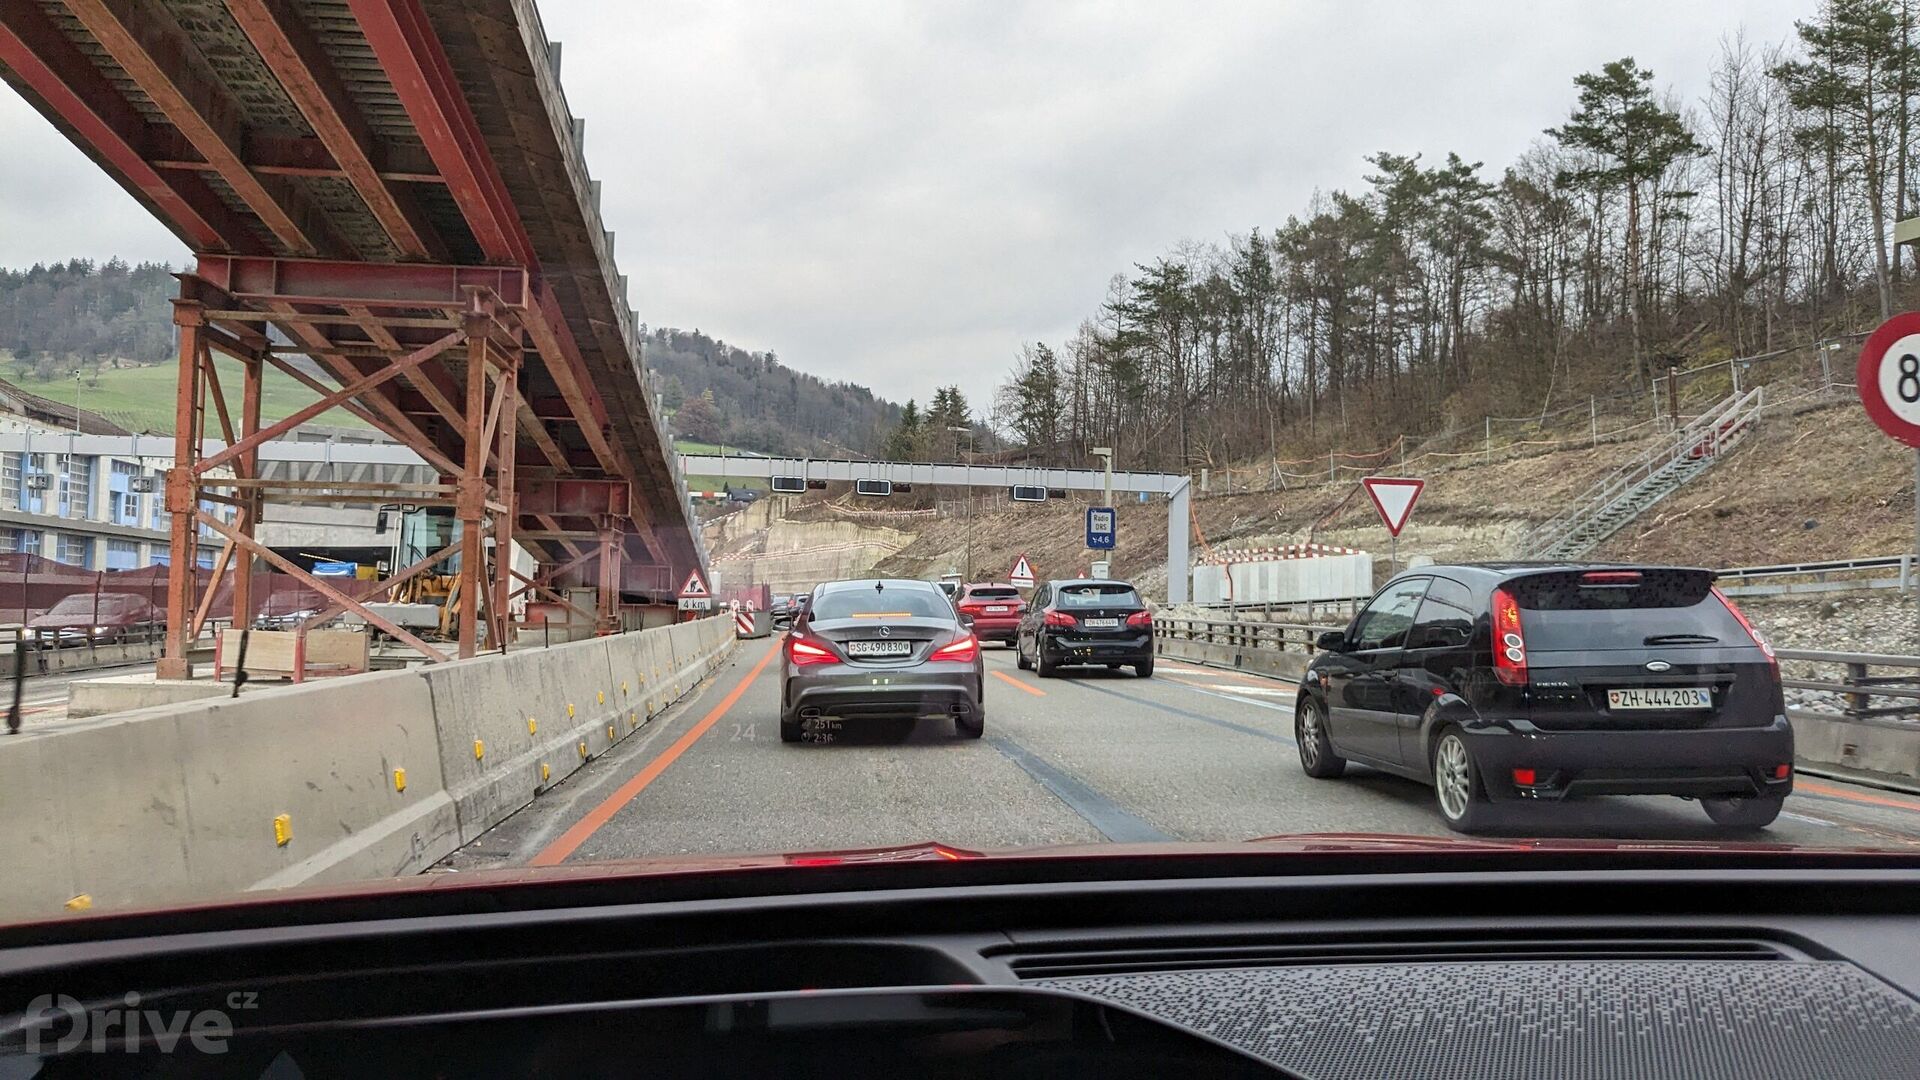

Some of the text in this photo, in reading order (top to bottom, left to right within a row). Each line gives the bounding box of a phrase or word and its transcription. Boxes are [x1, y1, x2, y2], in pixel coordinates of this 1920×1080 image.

[1093, 514, 1109, 522] Radio
[1095, 523, 1107, 531] DRS
[683, 599, 706, 609] 4 km
[814, 719, 831, 729] 251
[730, 722, 756, 742] 24
